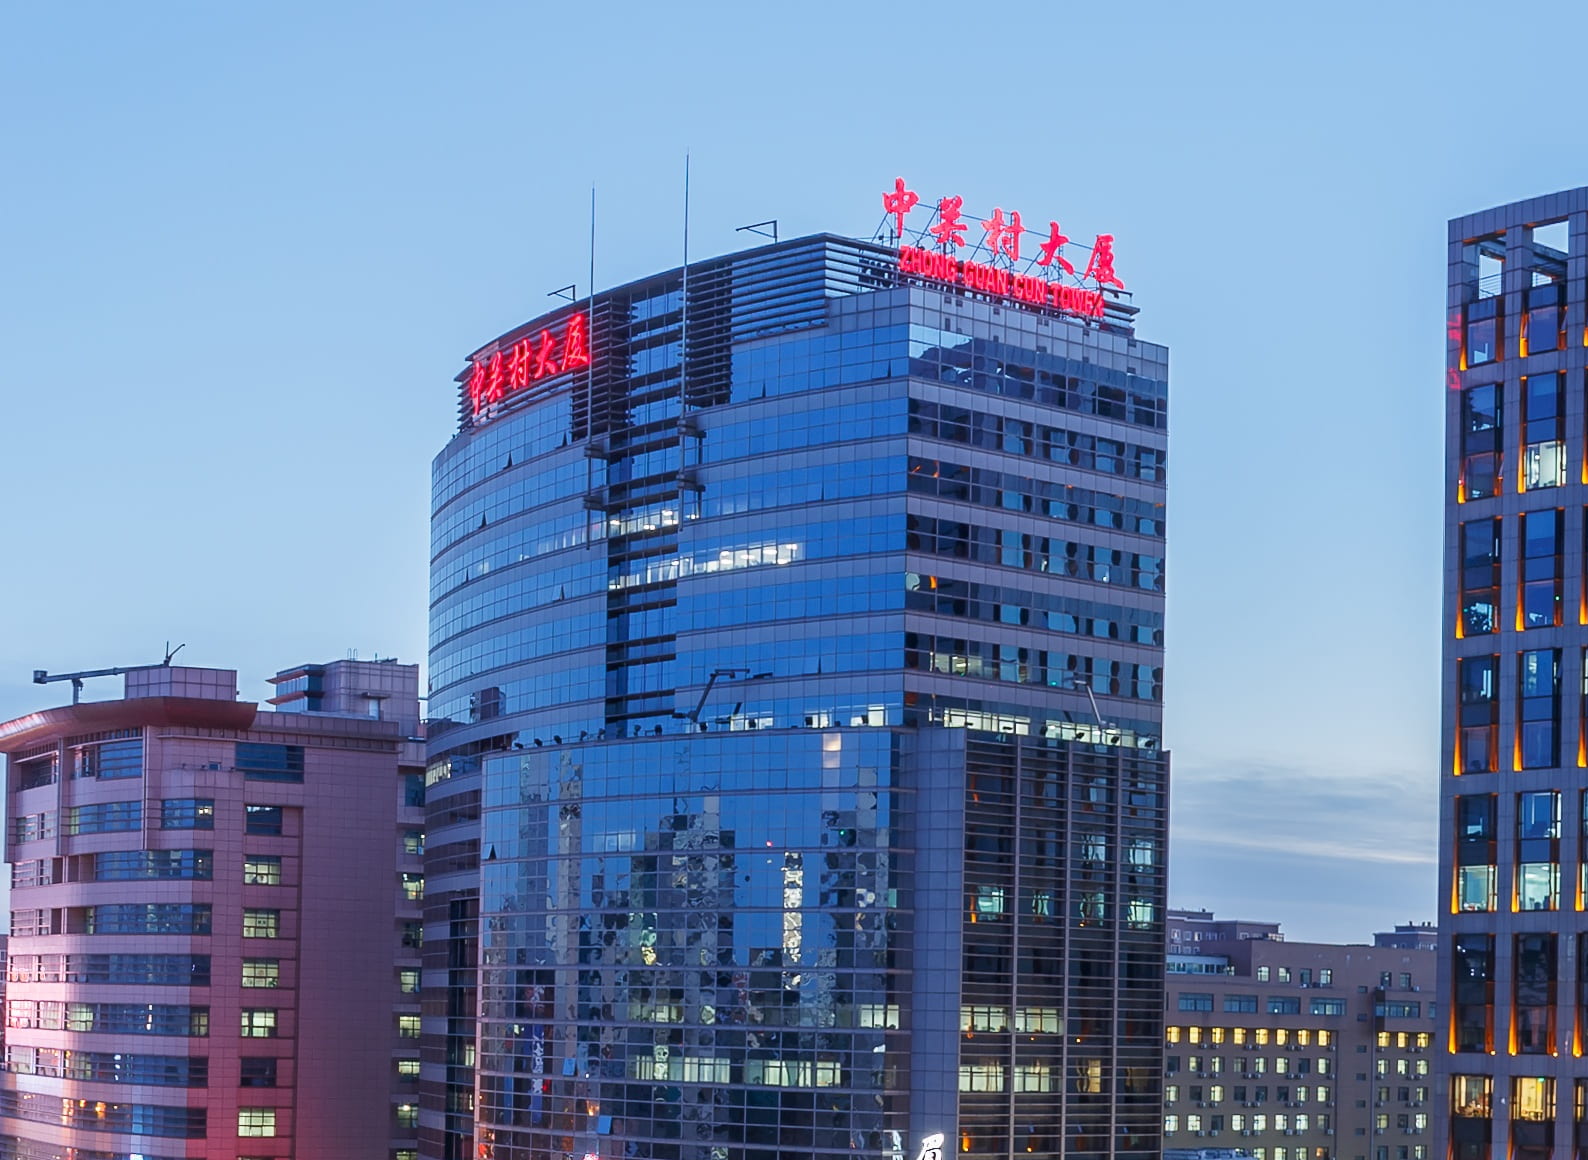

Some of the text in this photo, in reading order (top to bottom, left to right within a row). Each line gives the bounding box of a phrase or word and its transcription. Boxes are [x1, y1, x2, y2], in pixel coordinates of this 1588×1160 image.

[882, 176, 1124, 290] 中关村大厦
[899, 245, 1104, 318] ZHONG GUAN CUN TOWER
[470, 313, 591, 416] 中关村大厦
